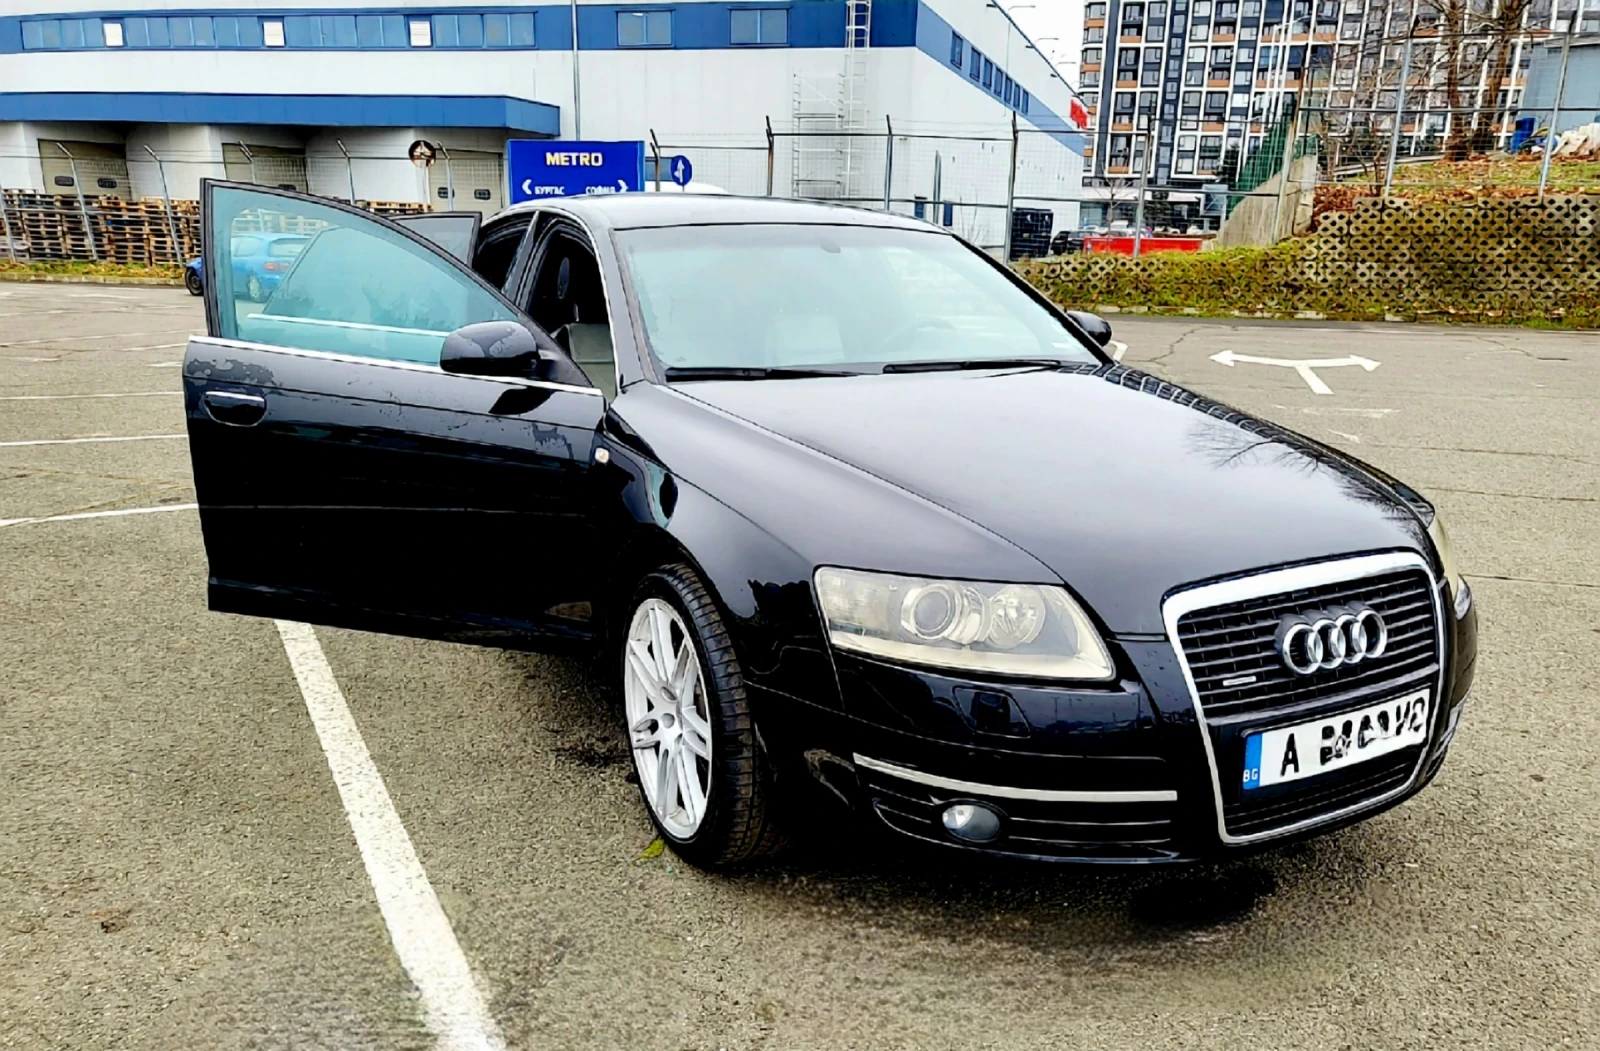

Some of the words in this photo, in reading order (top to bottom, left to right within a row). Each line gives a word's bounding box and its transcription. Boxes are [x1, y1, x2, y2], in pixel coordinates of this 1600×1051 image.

[545, 152, 603, 166] METRO
[534, 186, 565, 195] БУРГАС
[1242, 768, 1259, 783] BG
